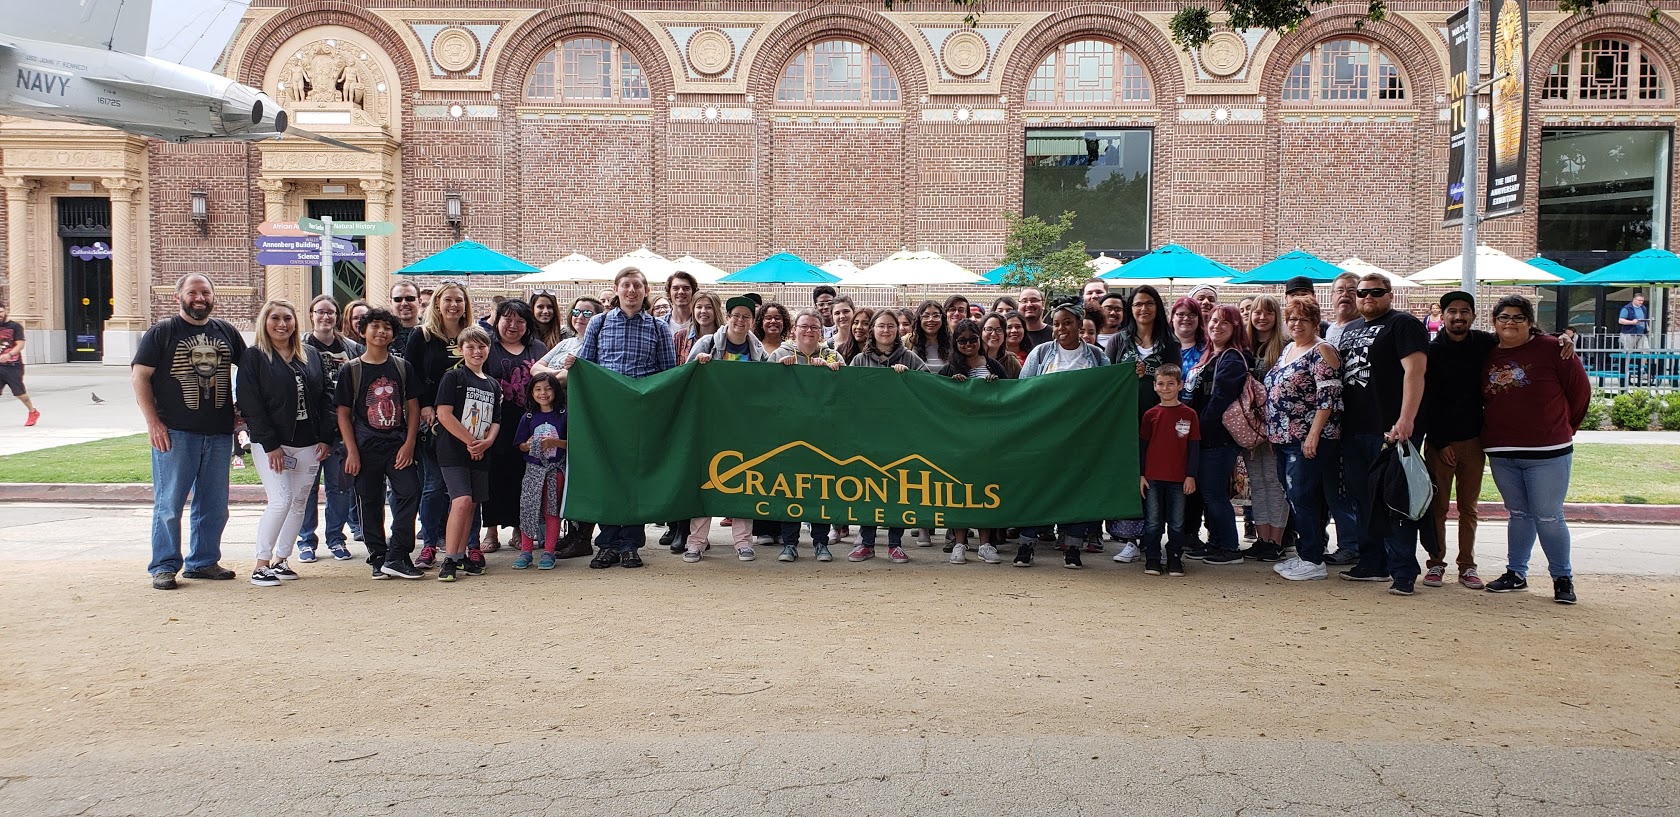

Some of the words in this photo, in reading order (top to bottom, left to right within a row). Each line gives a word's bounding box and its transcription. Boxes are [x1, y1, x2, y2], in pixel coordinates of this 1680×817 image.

[62, 62, 88, 72] KENNEDY
[16, 68, 70, 97] NAVY
[97, 96, 121, 108] 161725
[1495, 177, 1504, 186] THE
[1490, 183, 1520, 197] ANNIVERSARY
[1492, 193, 1517, 206] EXHIBITION
[355, 223, 376, 231] History
[262, 241, 295, 250] Annenberg
[295, 241, 320, 249] Building
[378, 419, 396, 427] TUT
[707, 450, 889, 504] CRAFTON
[896, 468, 1001, 509] HILLS
[755, 501, 945, 527] COLLEGE
